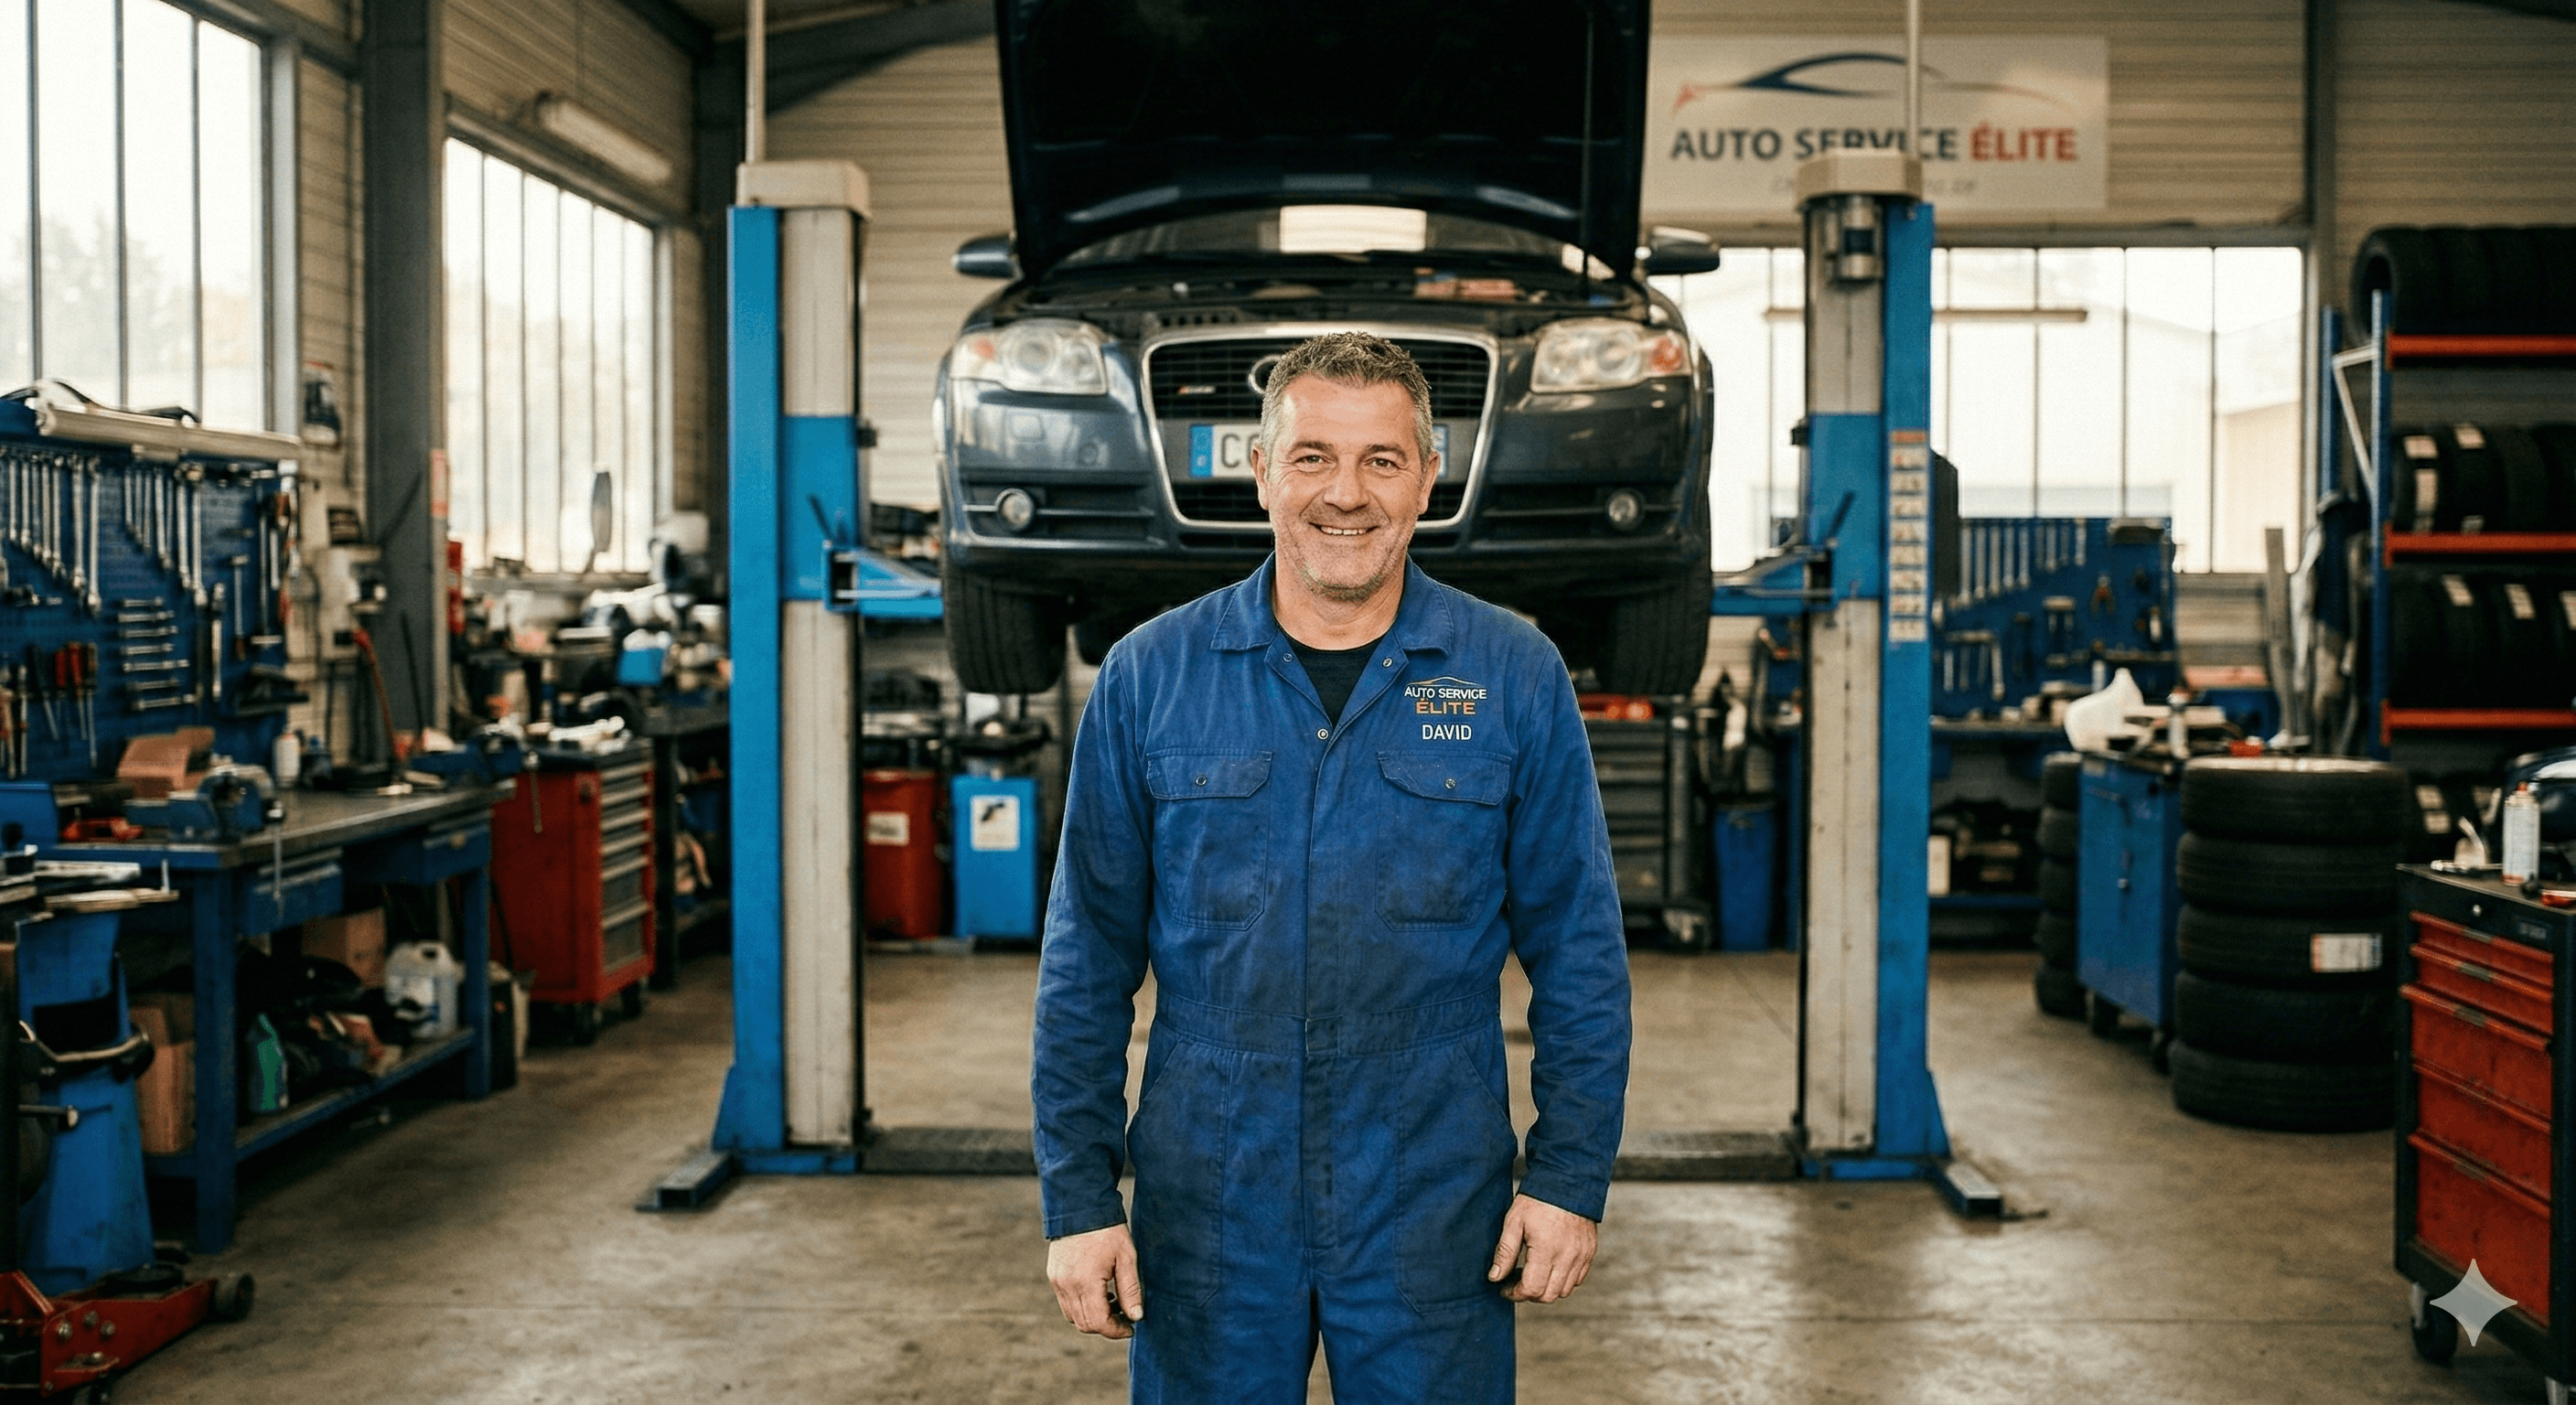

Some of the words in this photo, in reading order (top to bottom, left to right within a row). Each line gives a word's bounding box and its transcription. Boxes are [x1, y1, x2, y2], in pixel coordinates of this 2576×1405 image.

[1669, 127, 1784, 163] AUTO
[1970, 121, 2079, 163] ÉLITE
[1404, 686, 1435, 699] AUTO
[1416, 698, 1476, 715] ÉLITE
[1422, 724, 1472, 741] DAVID
